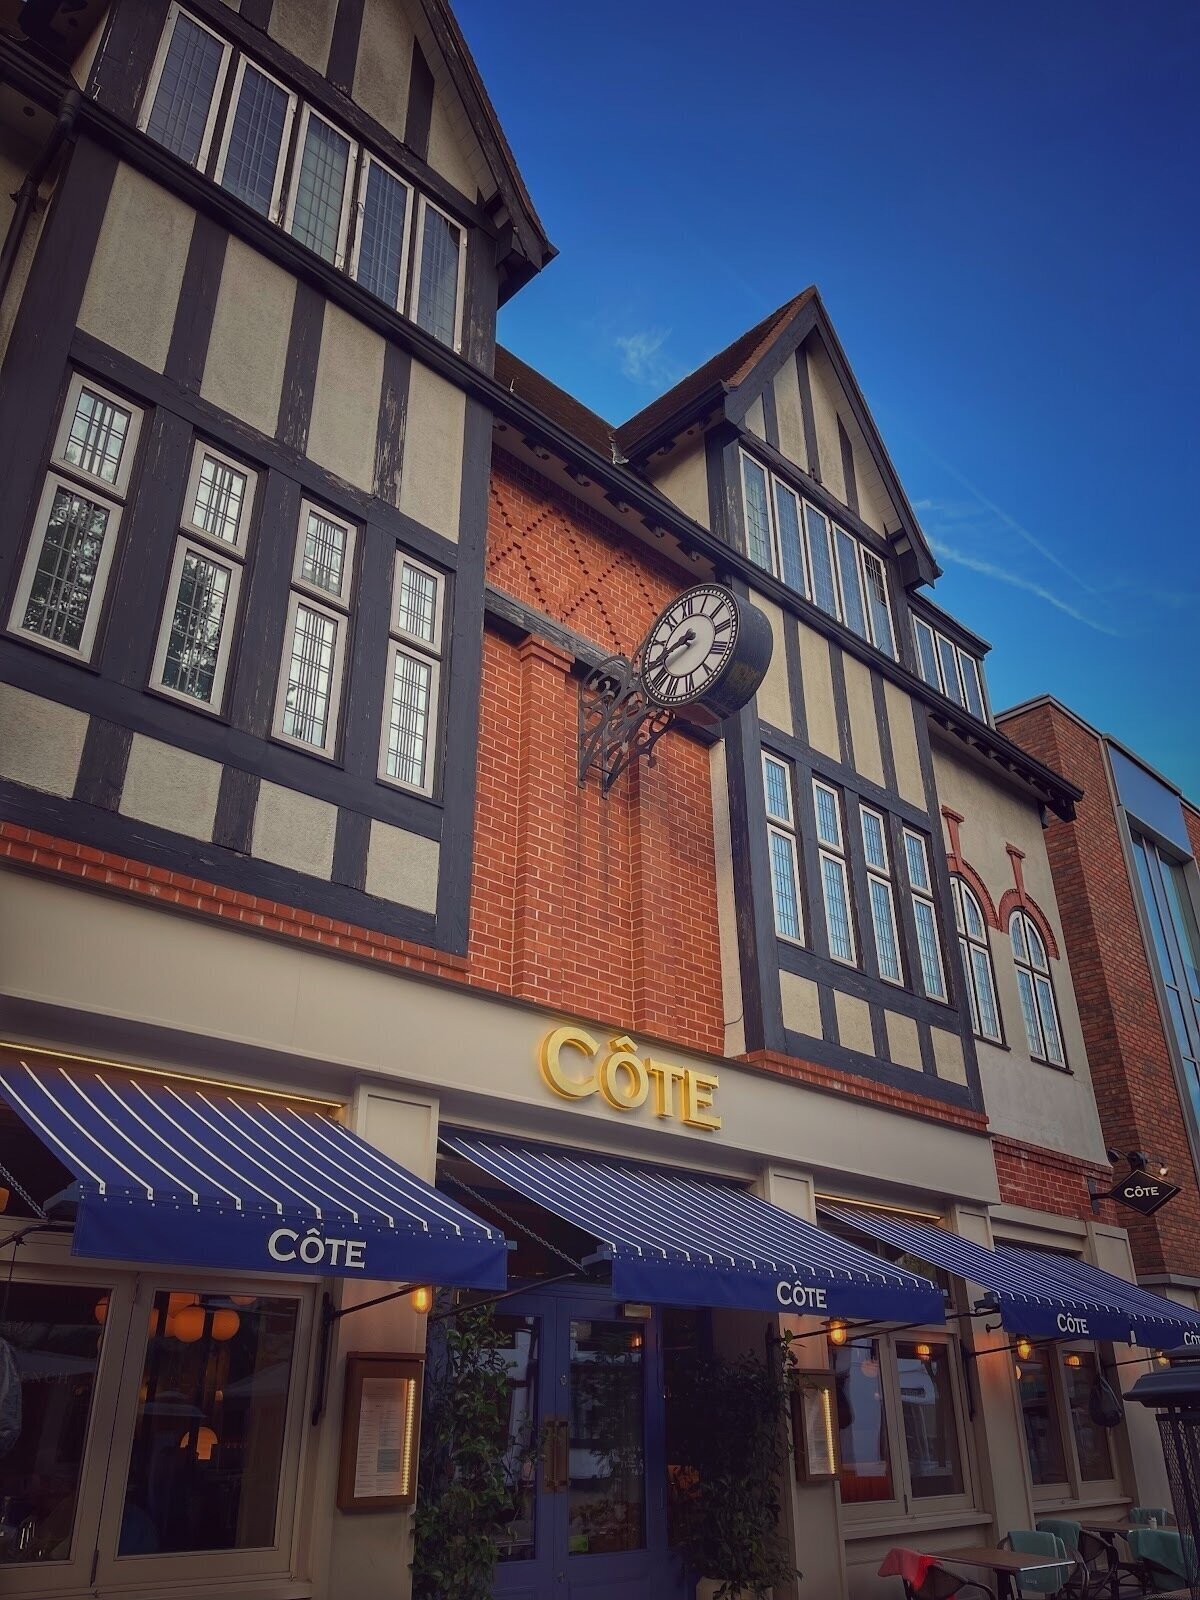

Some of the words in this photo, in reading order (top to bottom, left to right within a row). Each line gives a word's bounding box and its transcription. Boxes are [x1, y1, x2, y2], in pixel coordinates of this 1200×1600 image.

[681, 599, 693, 619] XII
[664, 614, 678, 632] XI
[714, 618, 731, 634] III
[710, 641, 728, 655] IIII
[539, 1026, 722, 1130] CÔTE
[1124, 1185, 1159, 1198] CÔTE
[267, 1228, 366, 1269] CÔTE
[777, 1280, 827, 1309] CÔTE
[1057, 1312, 1089, 1334] CÔTE
[1183, 1330, 1200, 1346] CÔT
